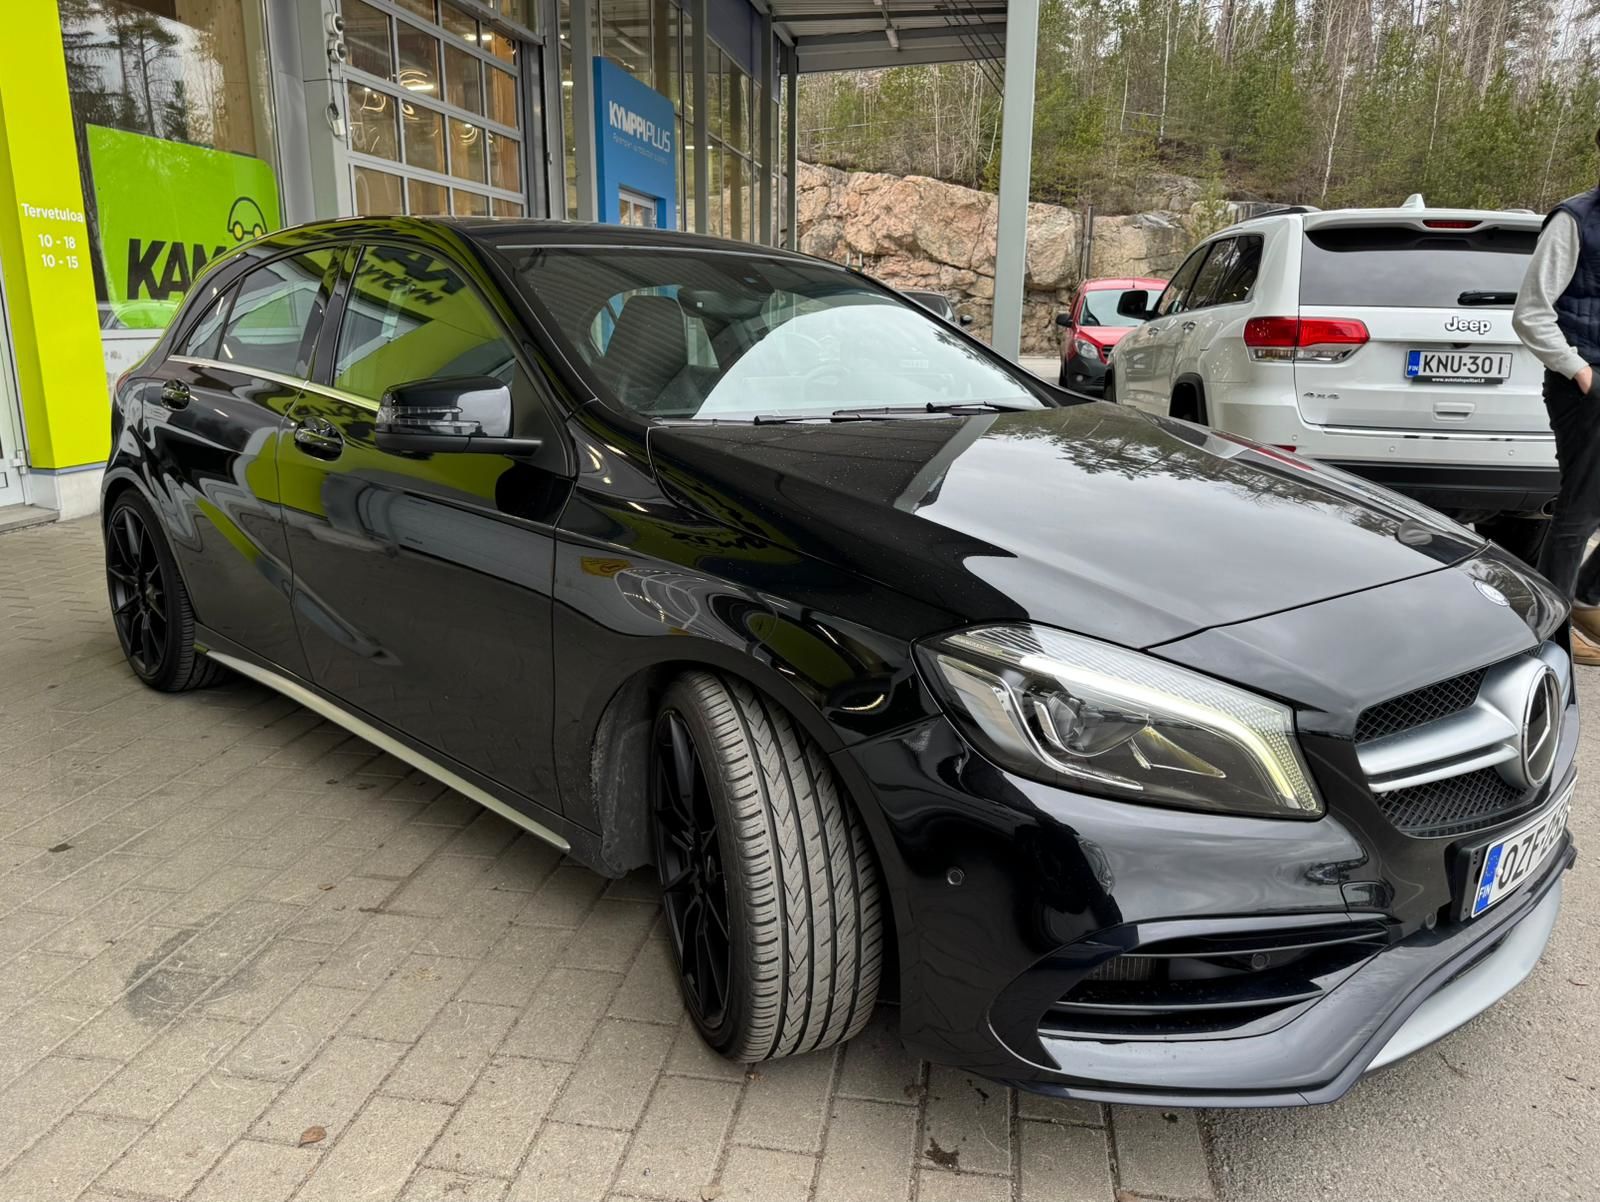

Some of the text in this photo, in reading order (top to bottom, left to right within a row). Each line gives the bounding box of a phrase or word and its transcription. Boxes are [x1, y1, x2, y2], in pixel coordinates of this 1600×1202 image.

[21, 203, 84, 223] Tervetuloa
[38, 234, 53, 248] 10
[64, 236, 76, 249] 18
[41, 254, 56, 268] 10
[66, 256, 79, 269] 15
[1445, 315, 1492, 335] Jeep
[1423, 354, 1504, 375] KNU-301
[1498, 797, 1568, 890] OZF-2
